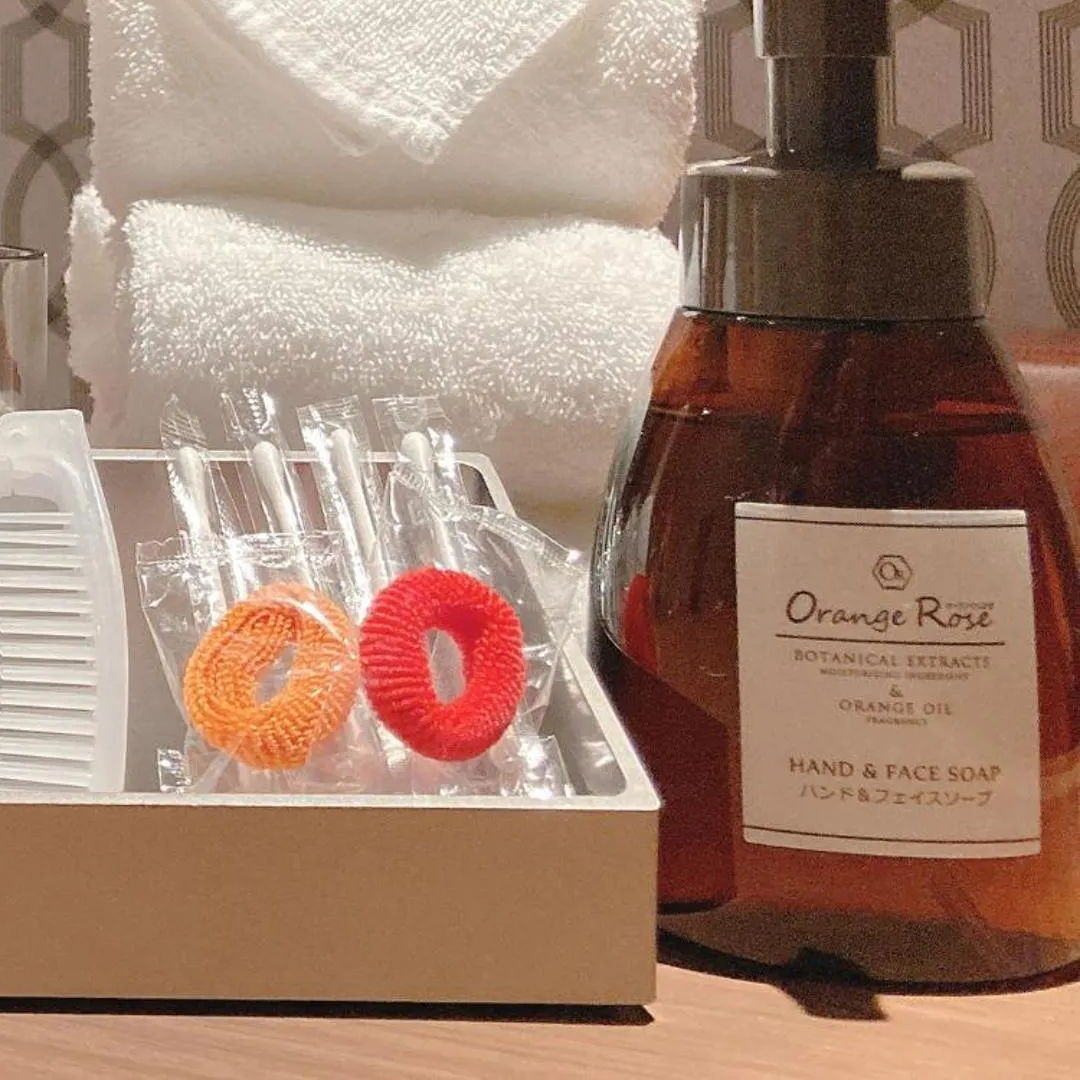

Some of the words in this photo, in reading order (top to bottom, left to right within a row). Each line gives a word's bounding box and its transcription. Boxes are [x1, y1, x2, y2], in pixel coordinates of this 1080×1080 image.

[785, 590, 906, 633] Orange
[915, 595, 993, 631] Rose
[794, 649, 898, 667] BOTANICAL
[907, 655, 991, 669] EXTRACTS
[889, 684, 904, 698] &
[838, 698, 915, 715] ORANGE
[923, 702, 953, 716] OIL
[789, 757, 854, 777] HAND
[862, 763, 877, 779] &
[885, 764, 941, 781] FACE
[948, 766, 1002, 782] SOAP
